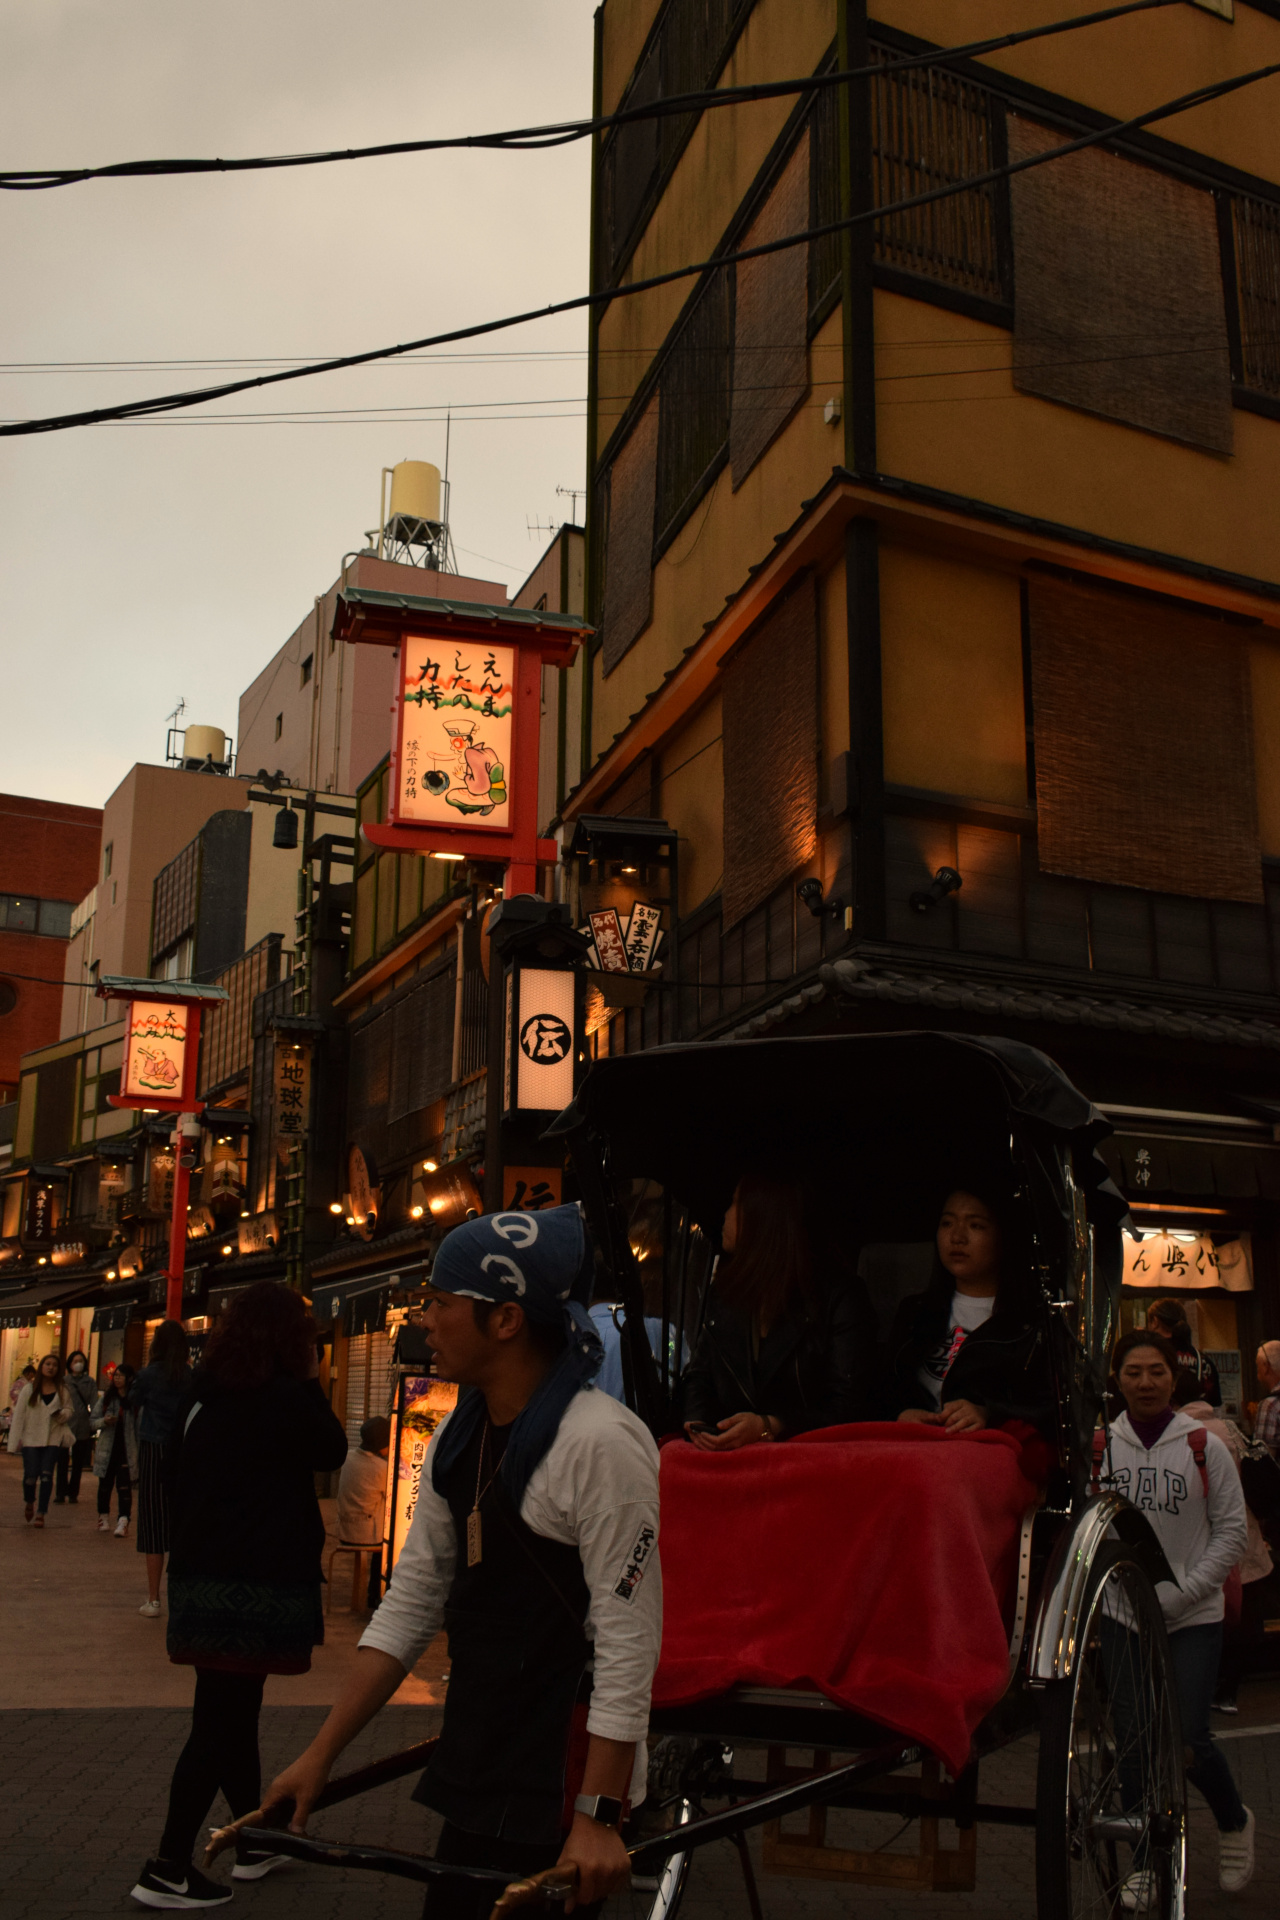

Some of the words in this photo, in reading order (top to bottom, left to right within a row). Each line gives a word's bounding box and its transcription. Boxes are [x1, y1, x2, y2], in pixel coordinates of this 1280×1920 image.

[415, 657, 445, 711] 力持
[452, 650, 474, 710] したの
[480, 652, 503, 718] えんま
[404, 739, 421, 800] 縁の下の力持
[592, 912, 616, 928] 名代
[635, 907, 659, 921] 名物
[146, 1014, 160, 1039] のみ
[163, 1009, 178, 1039] 大竹
[279, 1062, 305, 1134] 地球堂
[34, 1188, 48, 1238] 浅草ラスク
[1111, 1467, 1188, 1516] GAP
